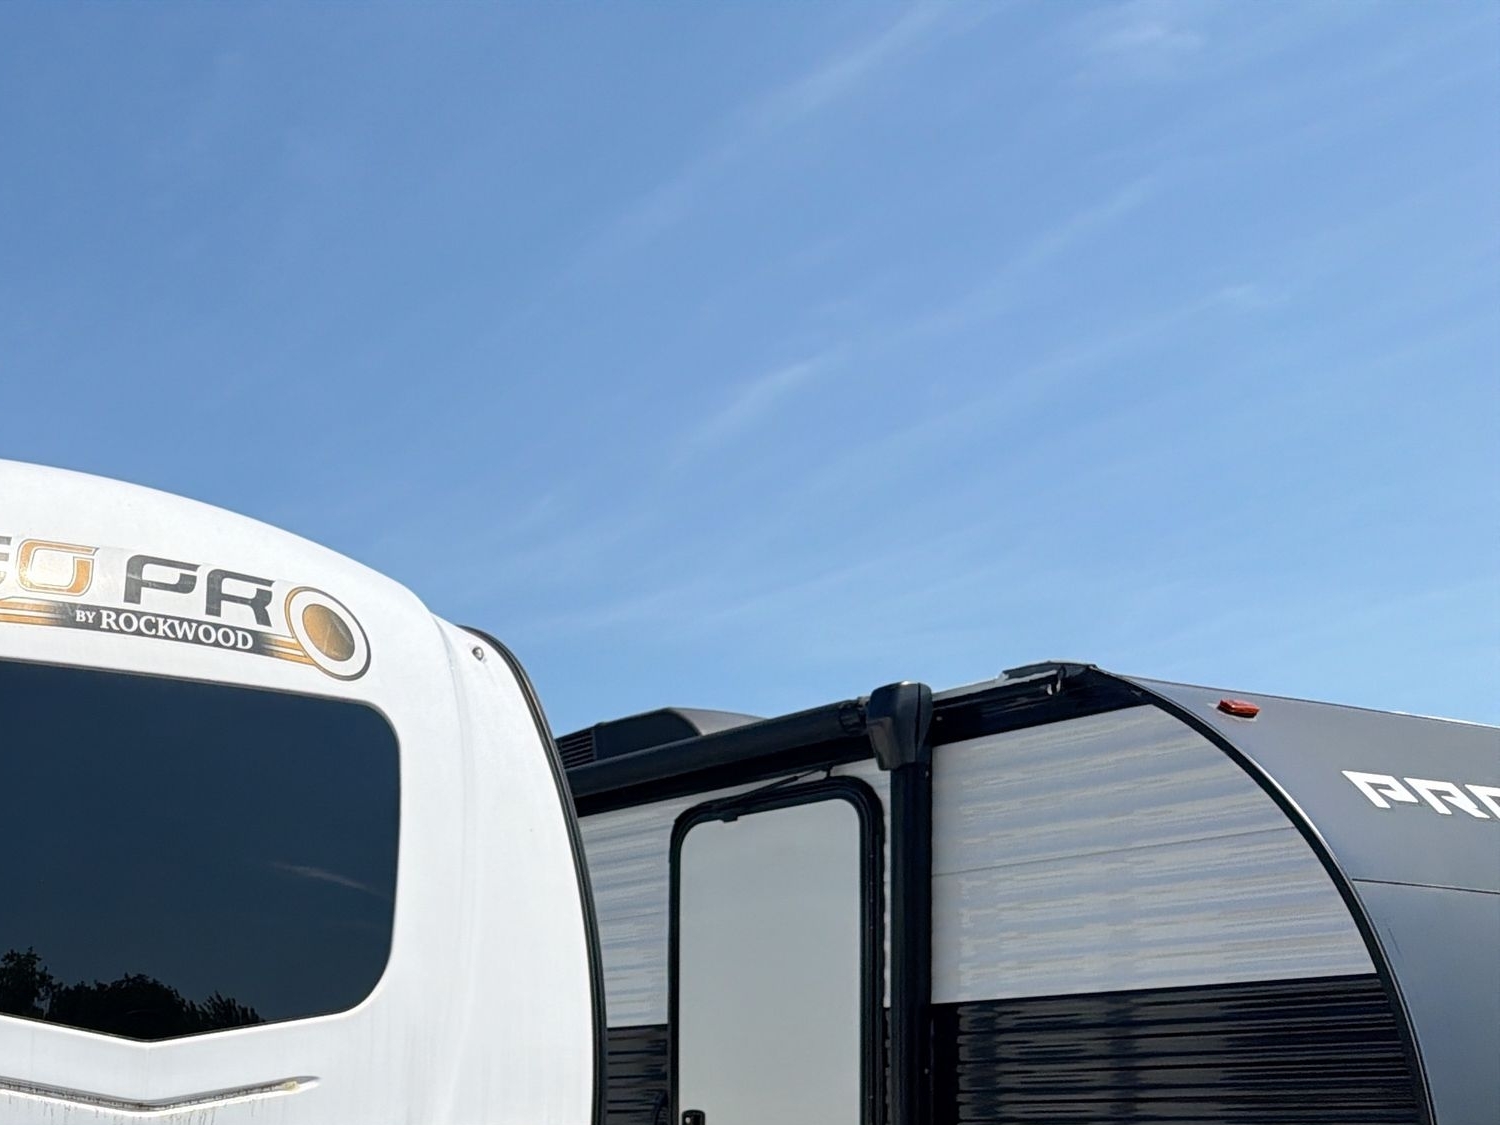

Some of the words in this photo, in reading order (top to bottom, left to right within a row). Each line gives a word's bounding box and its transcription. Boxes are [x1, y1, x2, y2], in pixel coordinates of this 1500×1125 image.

[75, 609, 97, 624] BY
[100, 610, 254, 651] ROCKWOOD
[123, 554, 371, 681] PRO
